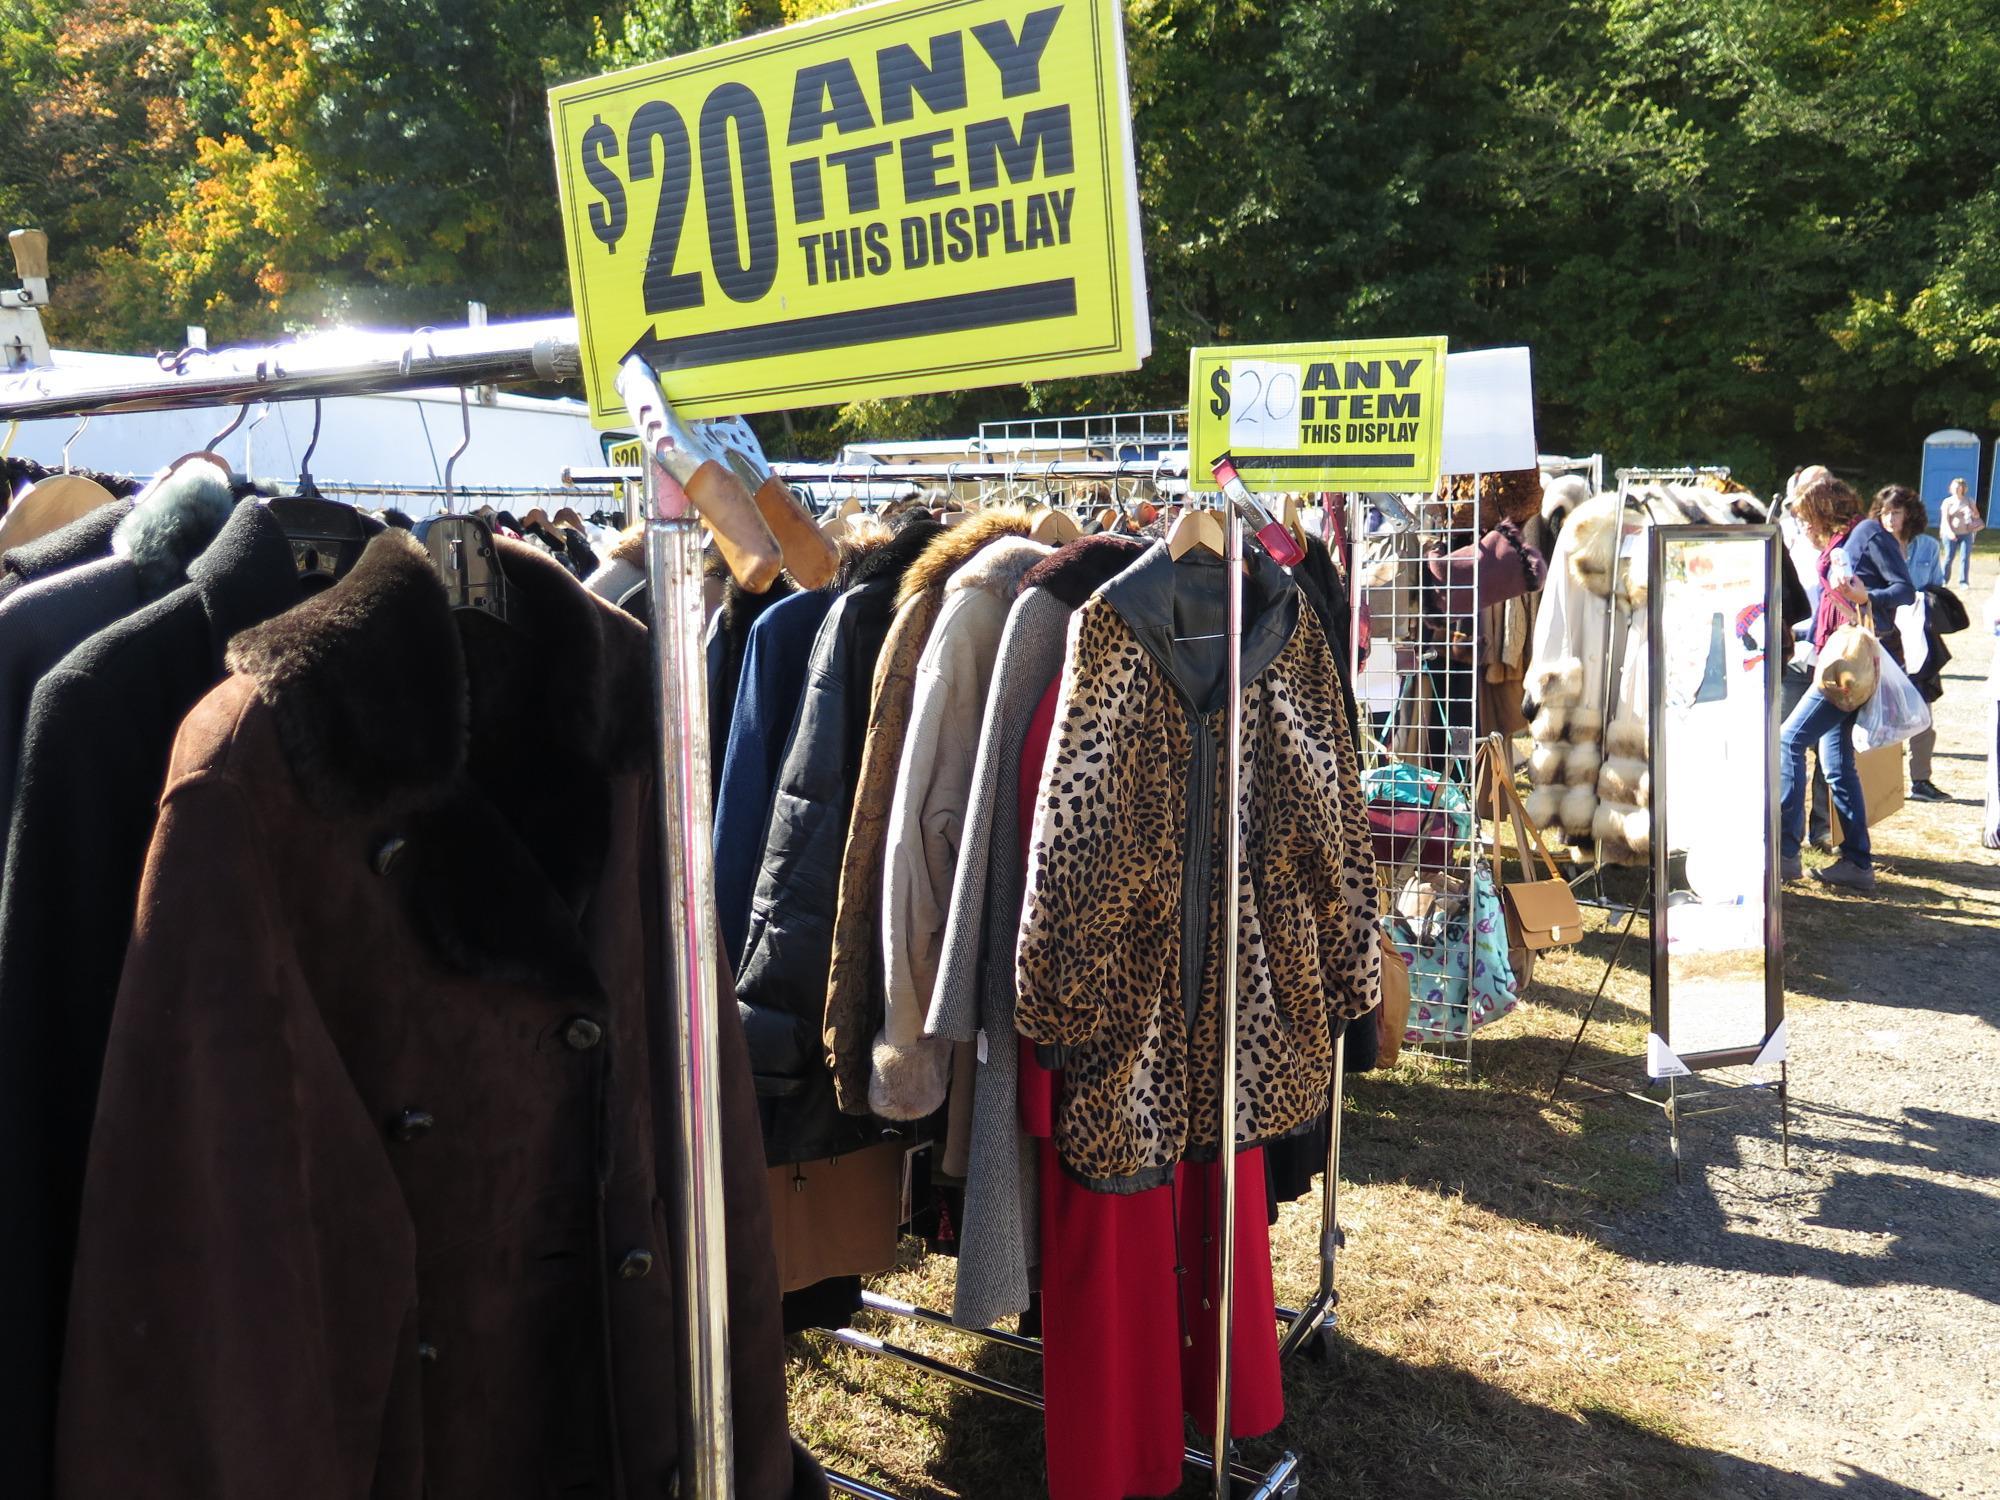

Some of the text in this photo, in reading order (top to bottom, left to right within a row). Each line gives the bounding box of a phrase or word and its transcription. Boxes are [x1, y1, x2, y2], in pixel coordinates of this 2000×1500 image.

[786, 5, 1065, 147] ANY
[581, 81, 779, 316] $20
[789, 103, 1075, 225] ITEM
[797, 187, 1076, 286] THIS DISPLAY
[1209, 365, 1297, 424] $20
[1301, 359, 1423, 391] ANY
[1301, 392, 1421, 420] ITEM
[1301, 422, 1420, 444] THIS DISPLAY
